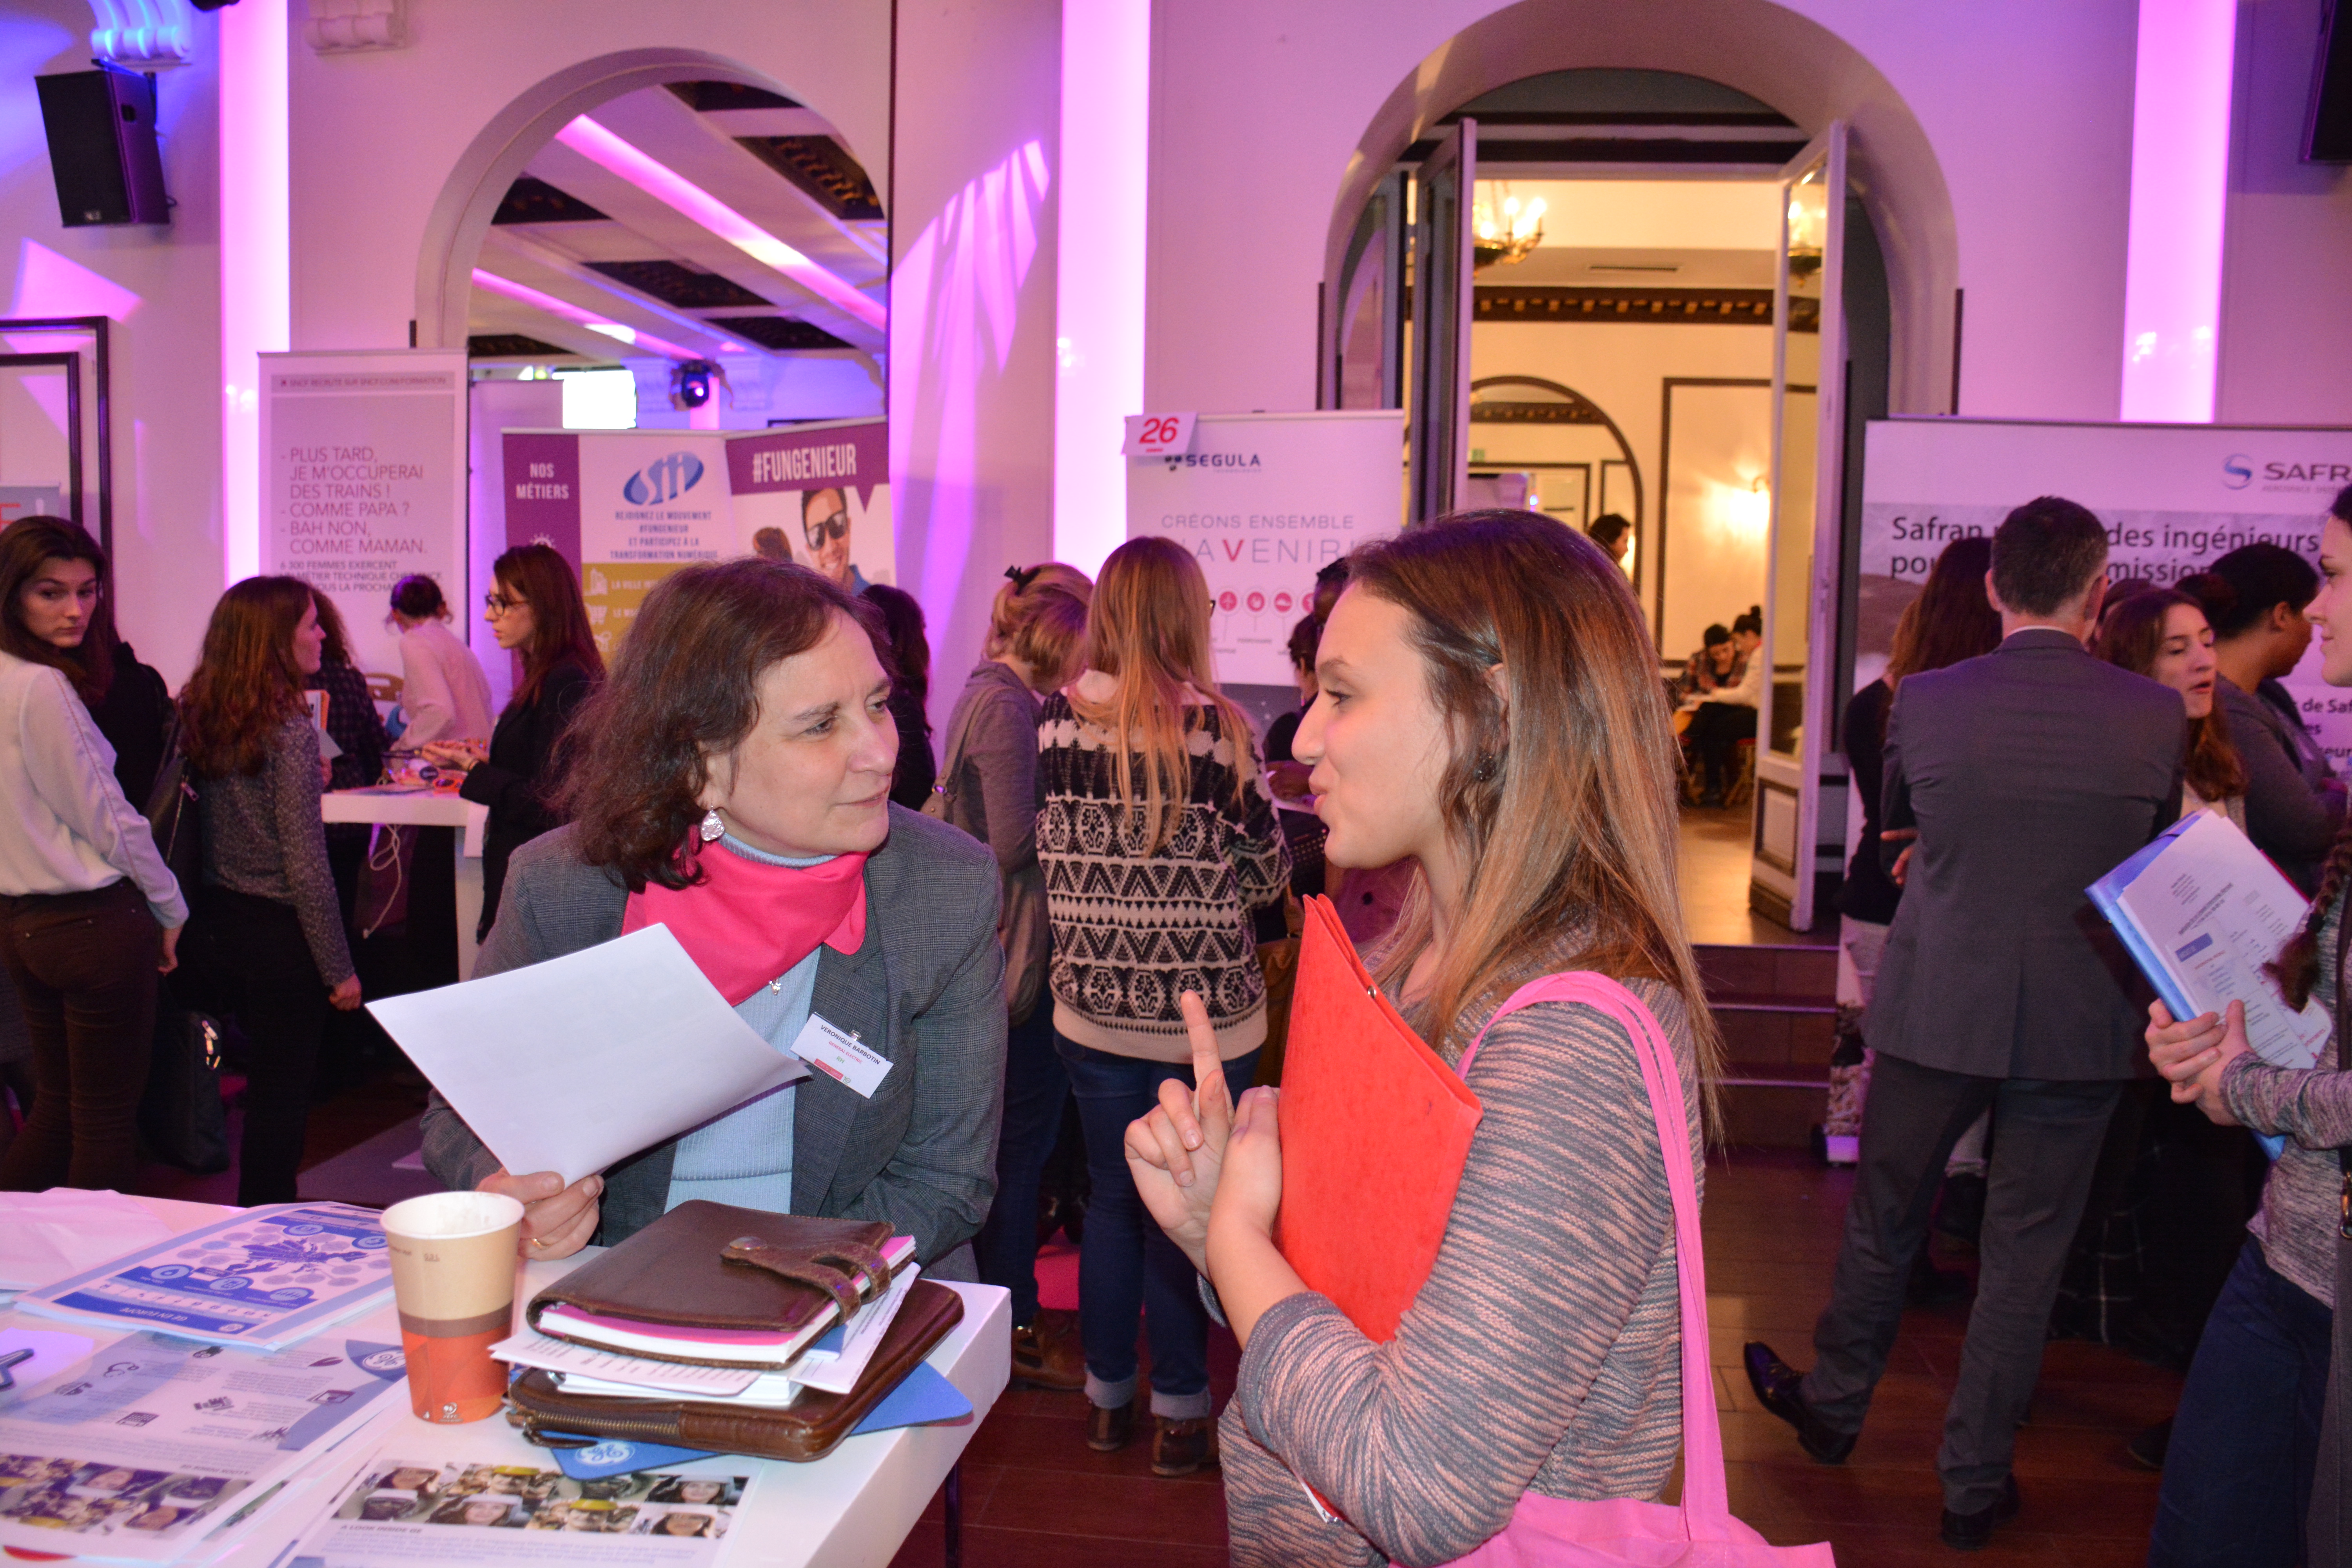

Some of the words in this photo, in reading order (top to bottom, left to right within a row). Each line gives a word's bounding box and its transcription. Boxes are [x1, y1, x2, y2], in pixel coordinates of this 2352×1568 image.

[1139, 417, 1179, 444] 26
[290, 447, 327, 462] PLUS
[333, 446, 377, 463] TARD,
[1186, 454, 1260, 467] SEGULA
[530, 463, 554, 478] NOS
[752, 443, 857, 483] #FUNGENIEUR
[290, 467, 307, 481] JE
[312, 465, 424, 480] M'OCCUPERAI
[290, 485, 321, 499] DES
[326, 483, 382, 498] TRAINS
[516, 482, 570, 500] MÉTIERS
[290, 503, 352, 517] COMME
[359, 502, 397, 517] PAPA
[290, 521, 323, 536] BAH
[328, 521, 371, 538] NON,
[1161, 514, 1241, 529] CRÉONS
[1249, 515, 1354, 529] ENSEMBLE
[1892, 516, 1983, 540] Safran
[2164, 524, 2319, 555] ingénieurs
[290, 540, 352, 554] COMME
[359, 539, 428, 554] MAMAN.
[820, 1025, 852, 1047] VERONIQUE
[852, 1045, 880, 1065] BARBOTIN
[828, 1041, 846, 1054] GENERAL
[846, 1051, 863, 1064] ELECTRIC
[836, 1056, 845, 1064] RH
